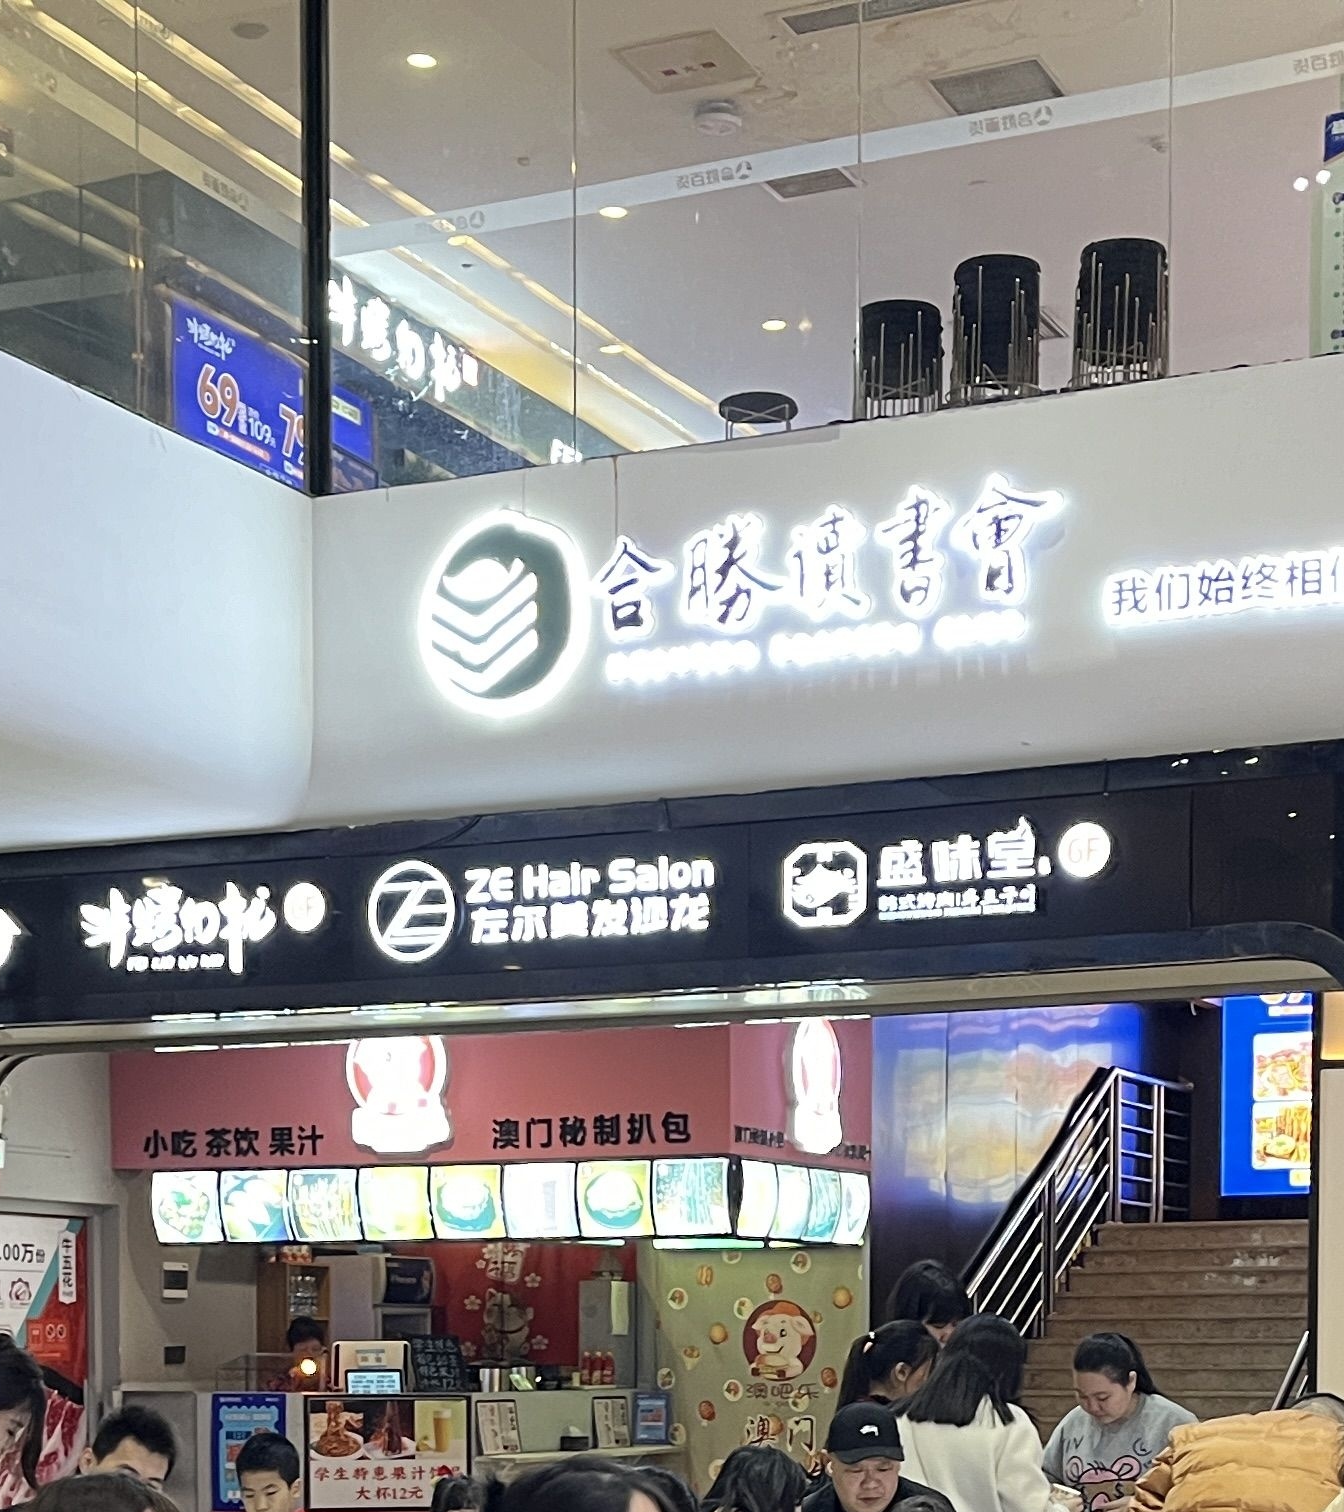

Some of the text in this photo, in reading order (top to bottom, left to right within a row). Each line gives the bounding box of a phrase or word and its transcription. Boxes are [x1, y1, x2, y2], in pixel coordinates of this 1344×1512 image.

[197, 362, 241, 427] 69
[876, 818, 1037, 888] 盛味堂
[464, 855, 715, 904] ZE Hair Salon
[143, 1124, 324, 1160] 小吃 茶饮 果汁
[491, 1111, 692, 1151] 澳门秘制扒包
[745, 1414, 816, 1454] 澳门
